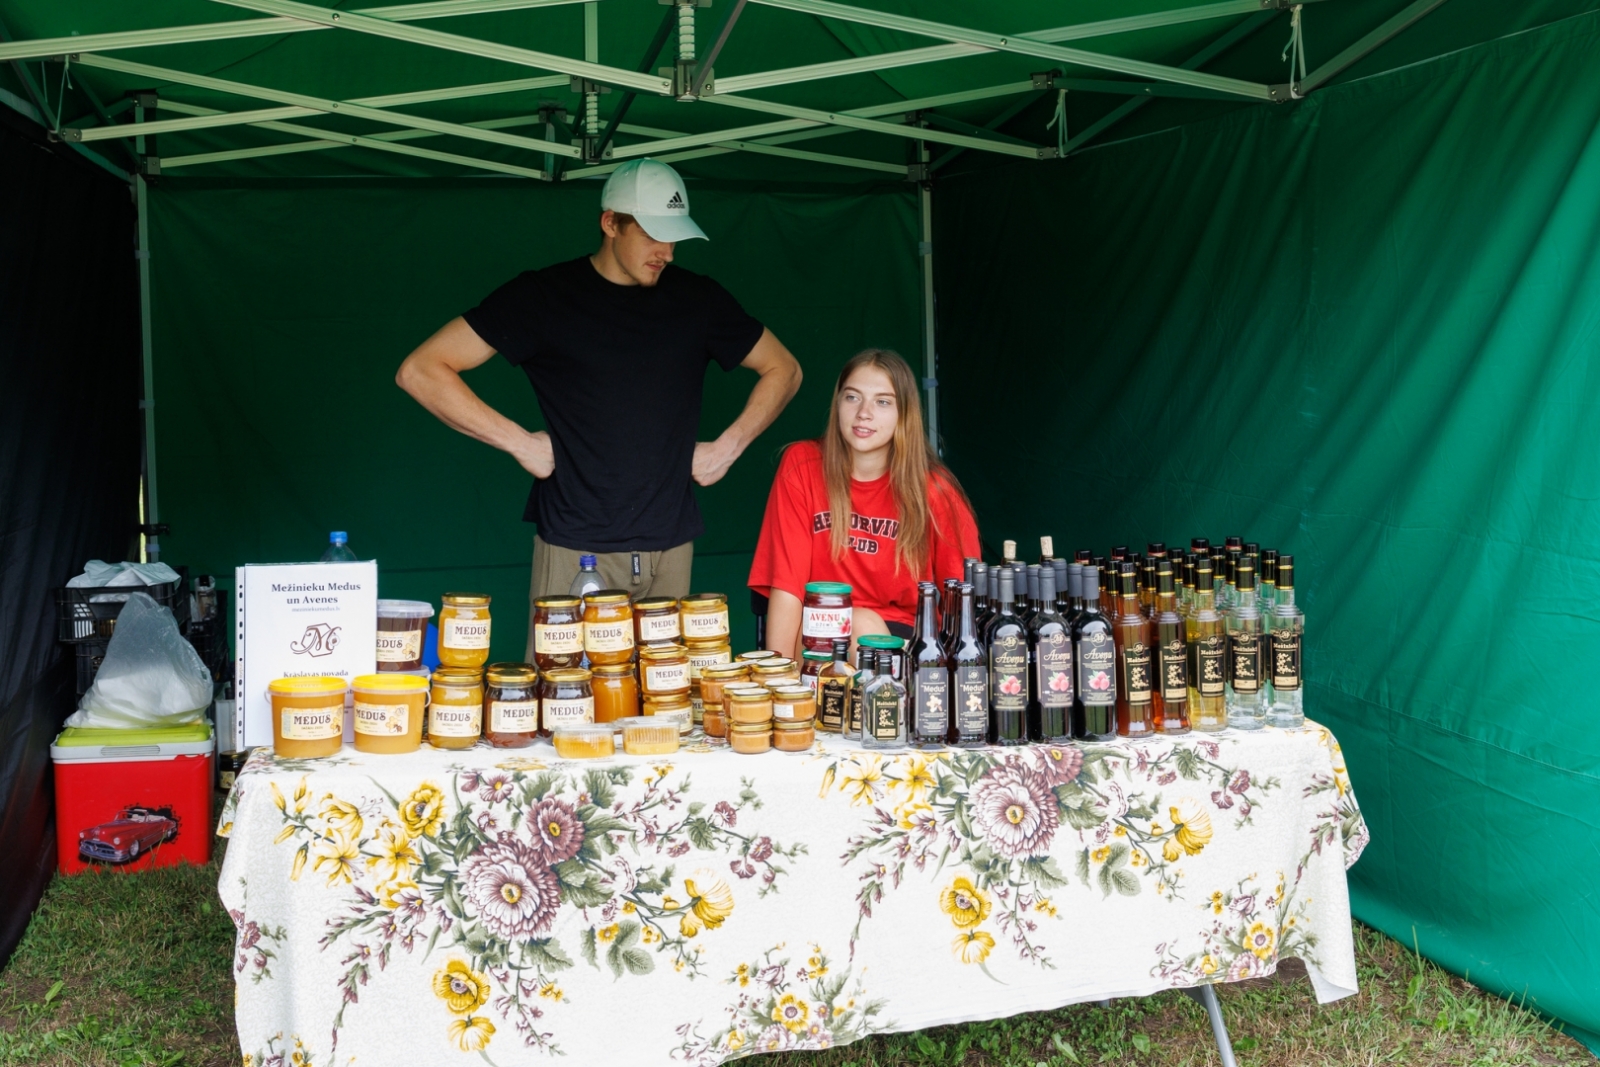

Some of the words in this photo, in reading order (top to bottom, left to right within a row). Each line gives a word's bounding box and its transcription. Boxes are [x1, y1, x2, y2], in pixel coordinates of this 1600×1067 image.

[850, 537, 878, 554] LUB
[271, 582, 325, 592] Mežinieku
[327, 582, 361, 591] Medus
[302, 596, 339, 604] Avenes
[650, 619, 676, 628] MEDUS
[691, 618, 719, 626] MEDUS
[455, 626, 487, 635] MEDUS
[589, 629, 622, 638] MEDUS
[544, 631, 577, 640] MEDUS
[376, 639, 403, 648] EDUS
[690, 659, 718, 667] MEDUS
[655, 669, 683, 678] MEDUS
[356, 709, 386, 720] MEDUS
[503, 709, 534, 718] MEDUS
[550, 706, 585, 716] MEDUS
[294, 715, 331, 725] MEDUS
[436, 711, 471, 721] MEDUS
